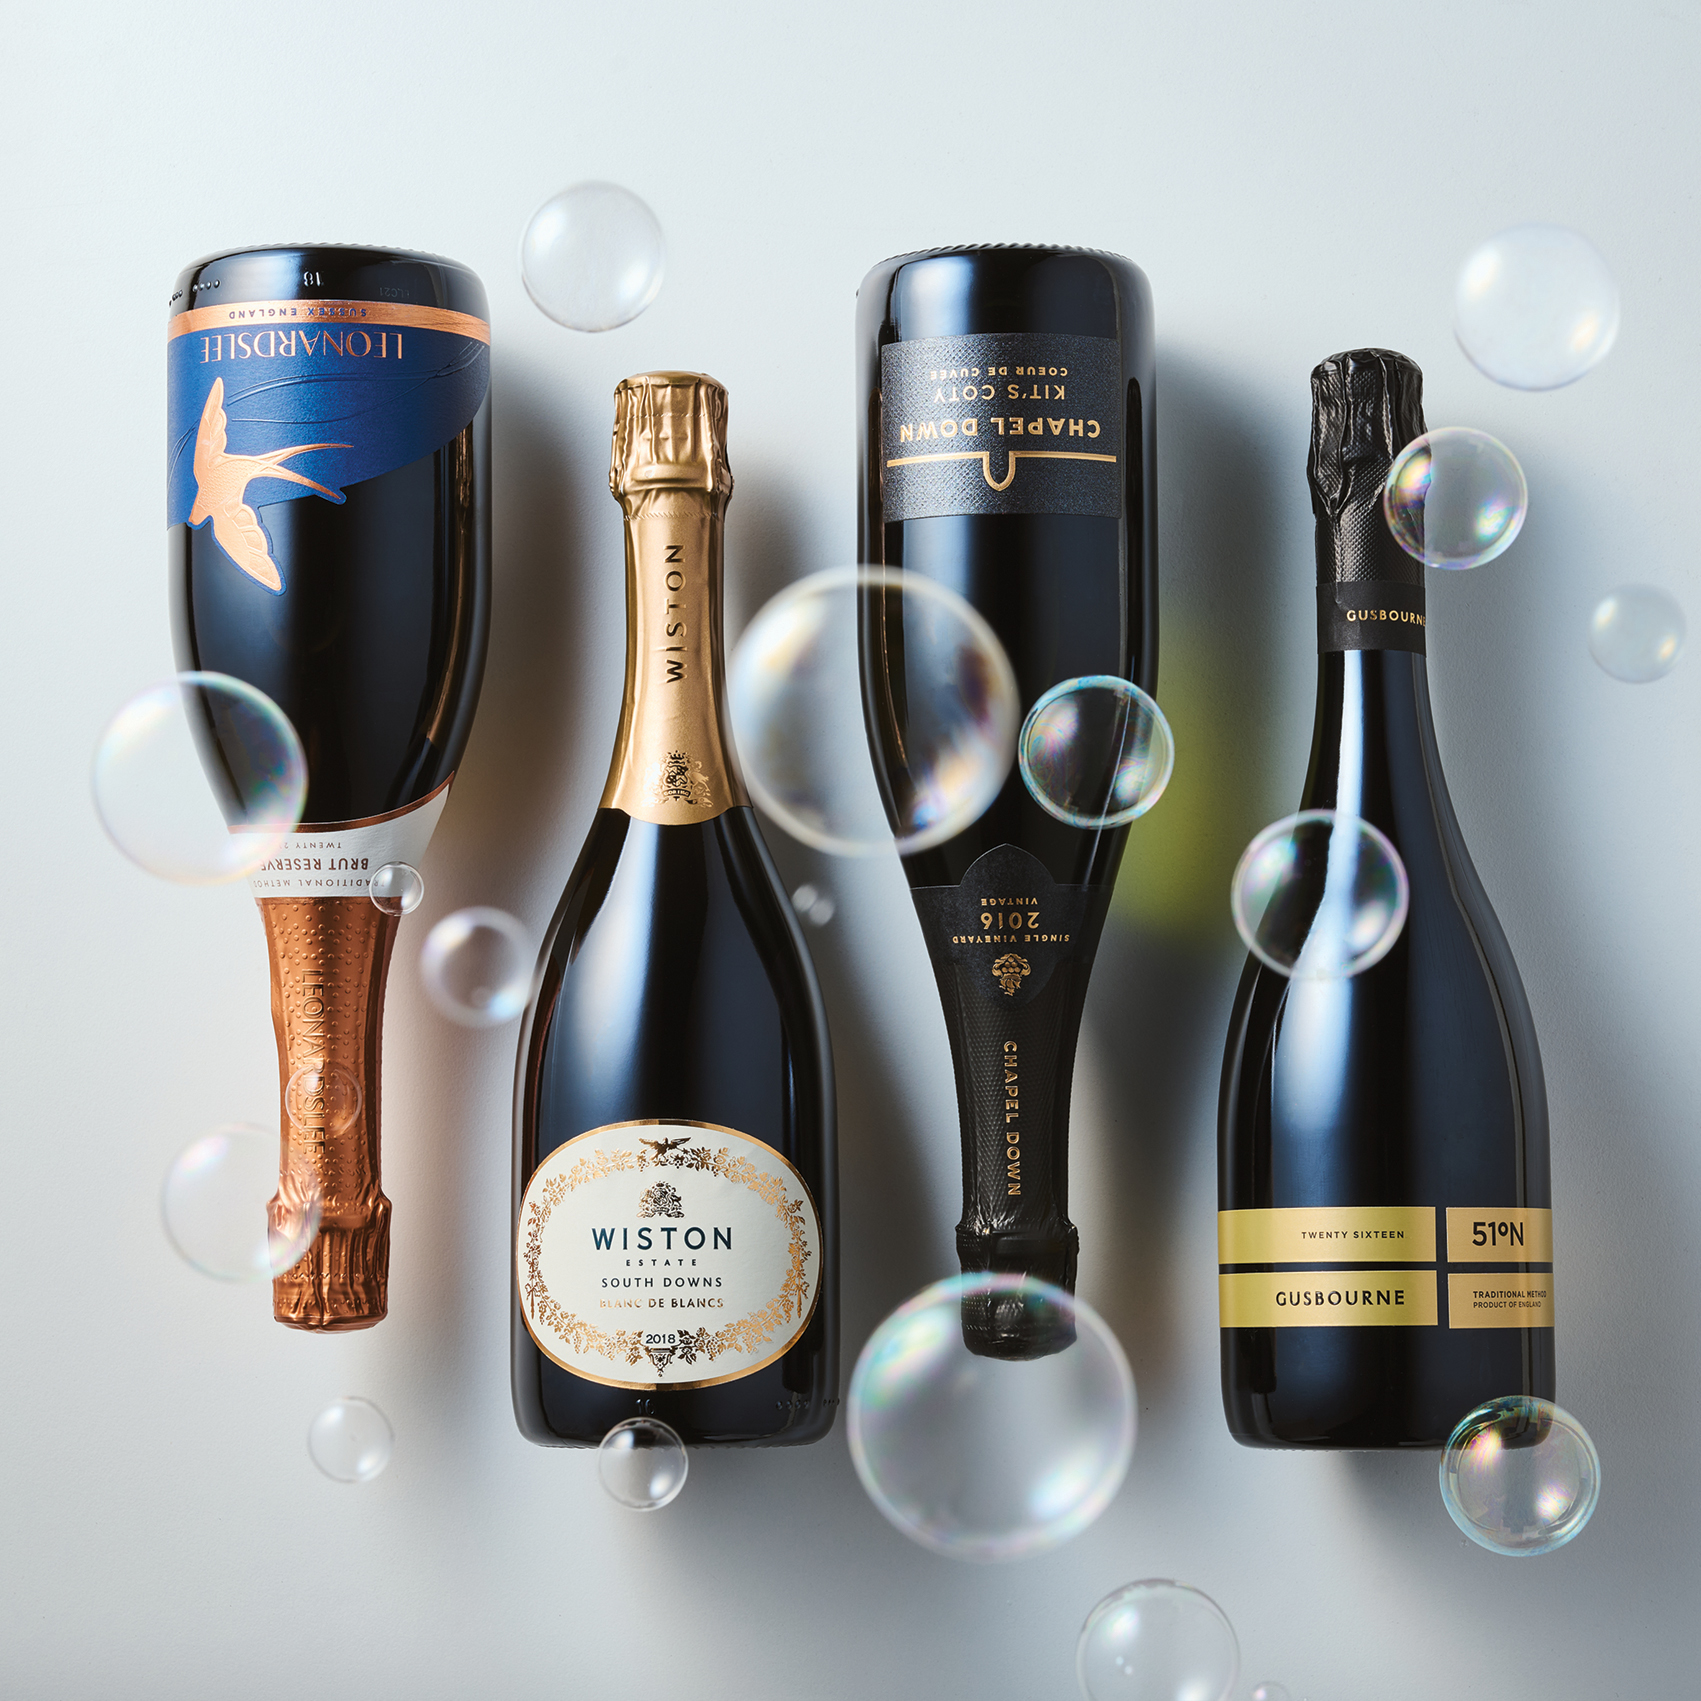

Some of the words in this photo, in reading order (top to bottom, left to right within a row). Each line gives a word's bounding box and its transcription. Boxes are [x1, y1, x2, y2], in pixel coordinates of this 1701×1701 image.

[229, 307, 298, 320] ENGLAND
[307, 306, 367, 318] SUSSEX
[200, 330, 403, 364] LEONARDSLEE
[930, 367, 980, 381] CUVÉE
[988, 366, 1008, 377] DE
[1016, 366, 1069, 377] COEUR
[934, 384, 996, 402] COTY
[1008, 384, 1066, 400] KIT'S
[900, 418, 978, 443] DOWN
[990, 417, 1101, 439] CHAPEL
[664, 544, 687, 684] WISTON
[328, 858, 369, 871] BRUT
[298, 879, 385, 888] TRADITIONAL
[981, 897, 1038, 906] VINTAGE
[980, 912, 1040, 930] 2016
[952, 935, 1017, 944] VINEYARD
[1024, 934, 1070, 943] SINGLE
[301, 969, 326, 1155] LEONARDSLEE
[1003, 1040, 1019, 1124] CHAPEL
[1006, 1132, 1022, 1196] DOWN
[591, 1226, 732, 1251] WISTON
[1301, 1230, 1348, 1239] TWENTY
[1353, 1230, 1405, 1239] SIXTEEN
[626, 1258, 697, 1267] ESTATE
[601, 1277, 654, 1288] SOUTH
[663, 1277, 723, 1288] DOWNS
[1276, 1290, 1405, 1306] GUSBOURNE
[1472, 1290, 1526, 1299] TRADITIONAL
[1526, 1290, 1547, 1298] METHOD
[599, 1298, 643, 1309] BLANC
[648, 1298, 665, 1309] DE
[671, 1298, 725, 1309] BLANCS
[645, 1333, 676, 1345] 2018
